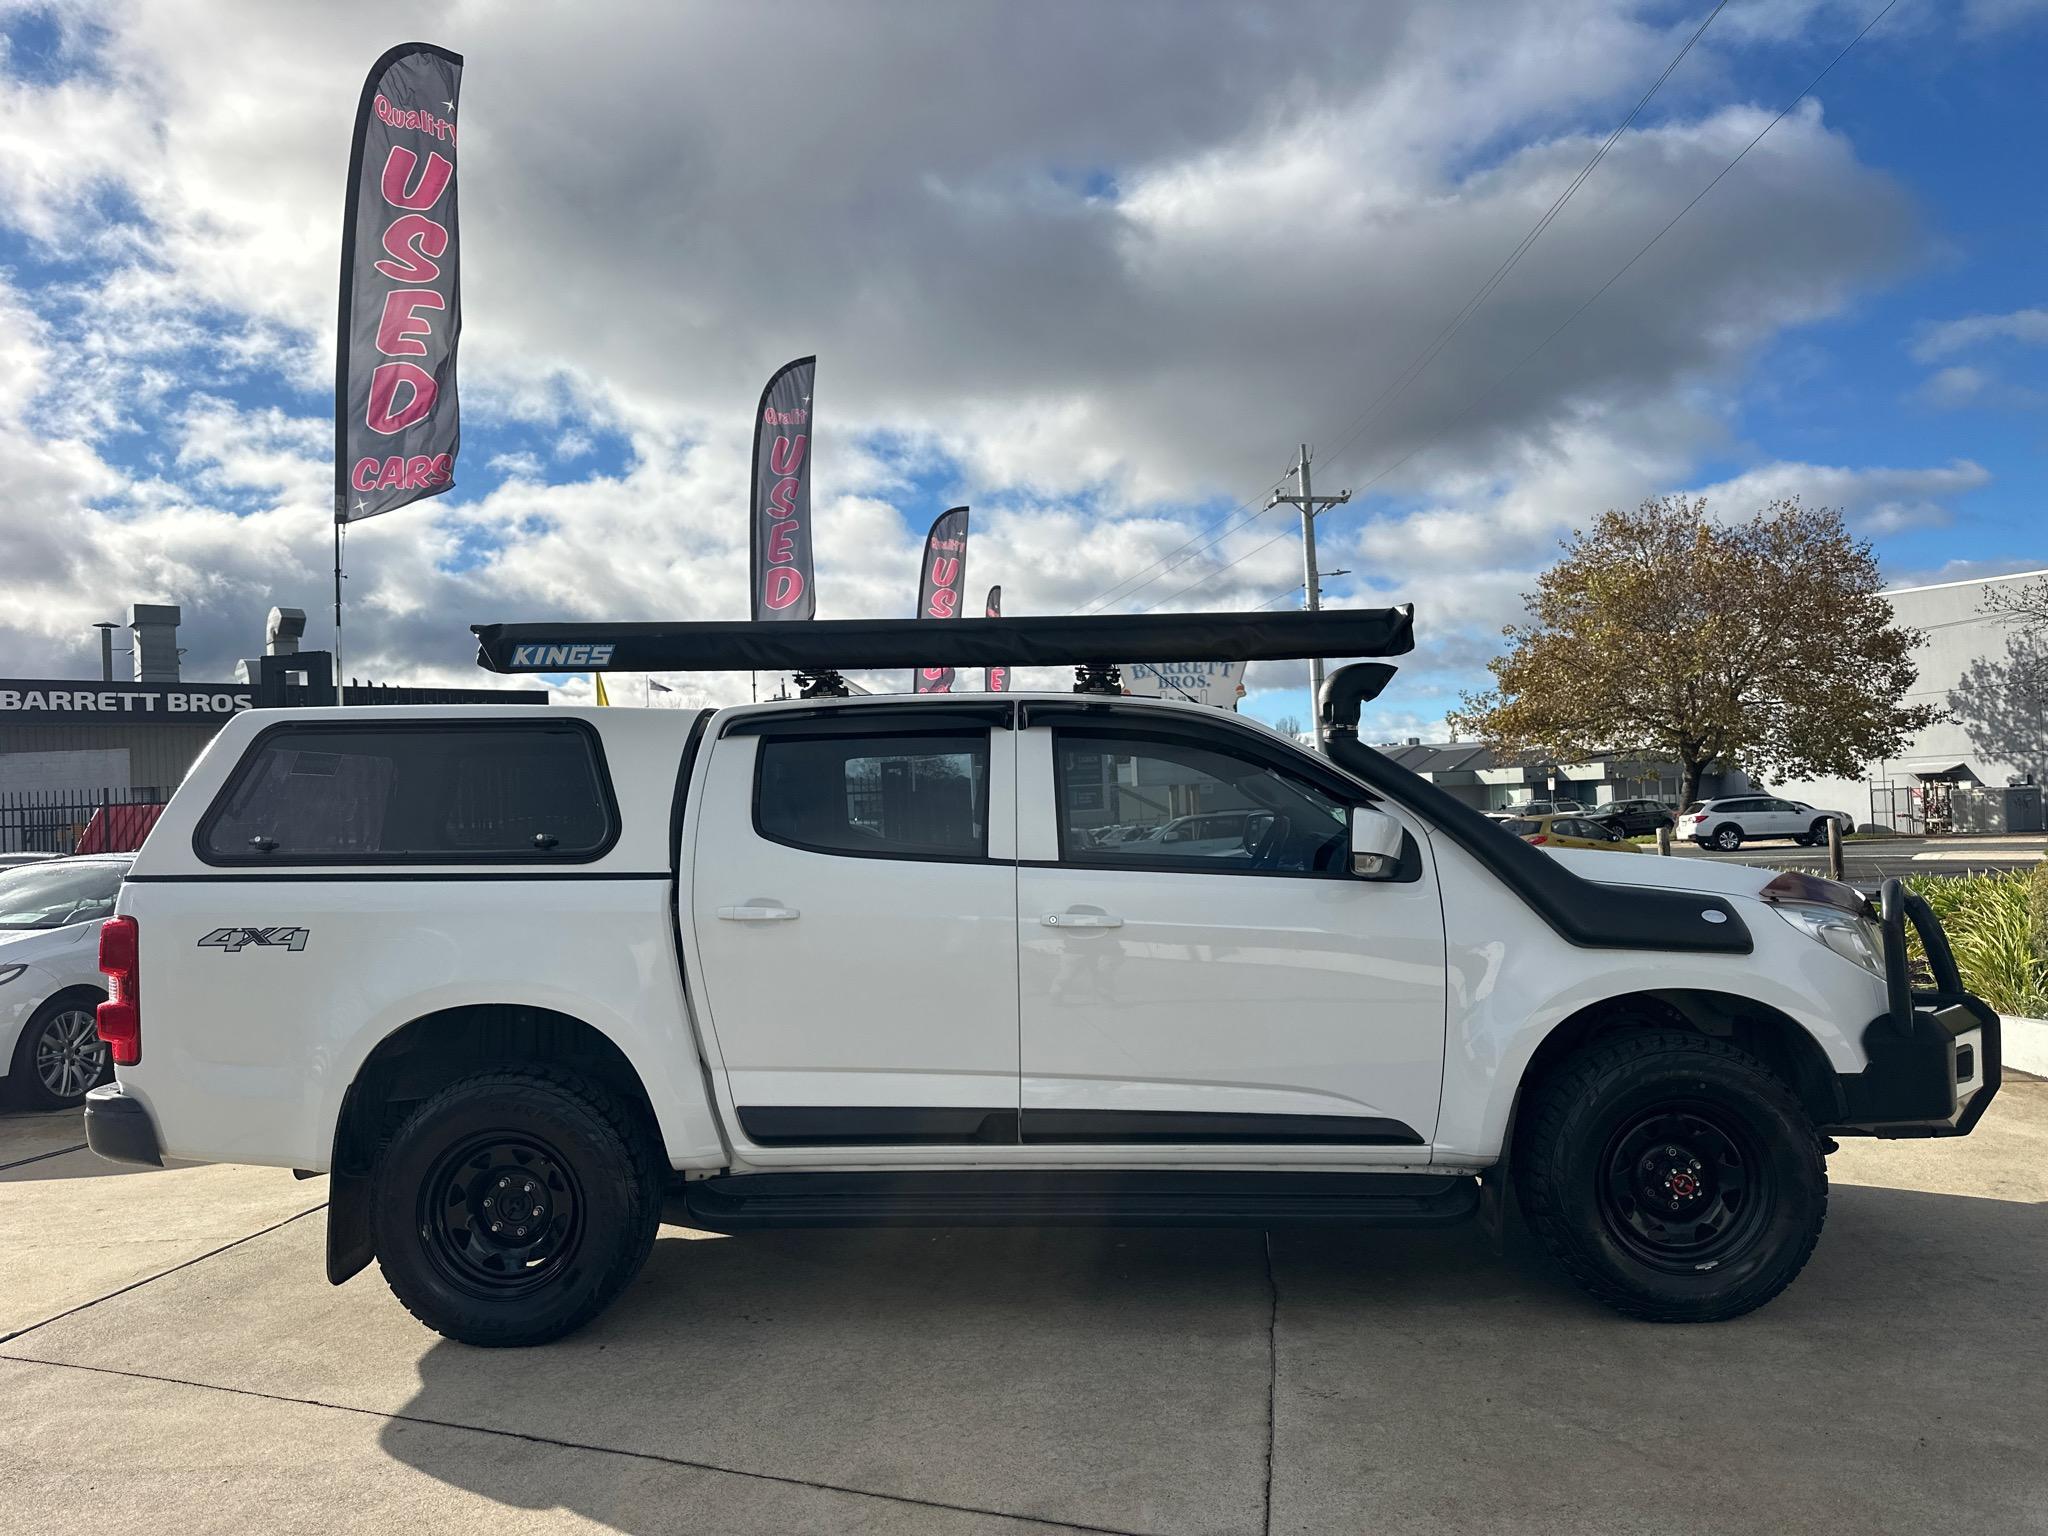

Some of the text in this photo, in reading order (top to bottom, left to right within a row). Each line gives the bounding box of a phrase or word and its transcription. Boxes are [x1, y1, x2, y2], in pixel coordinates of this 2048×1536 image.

[373, 94, 457, 148] Quality
[366, 146, 453, 435] USED
[352, 453, 453, 491] CARS
[764, 434, 807, 610] USED
[511, 645, 615, 667] KINGS
[1131, 662, 1235, 679] BARRETT
[1158, 675, 1211, 689] BROS.
[0, 690, 253, 712] BARRETT BROS
